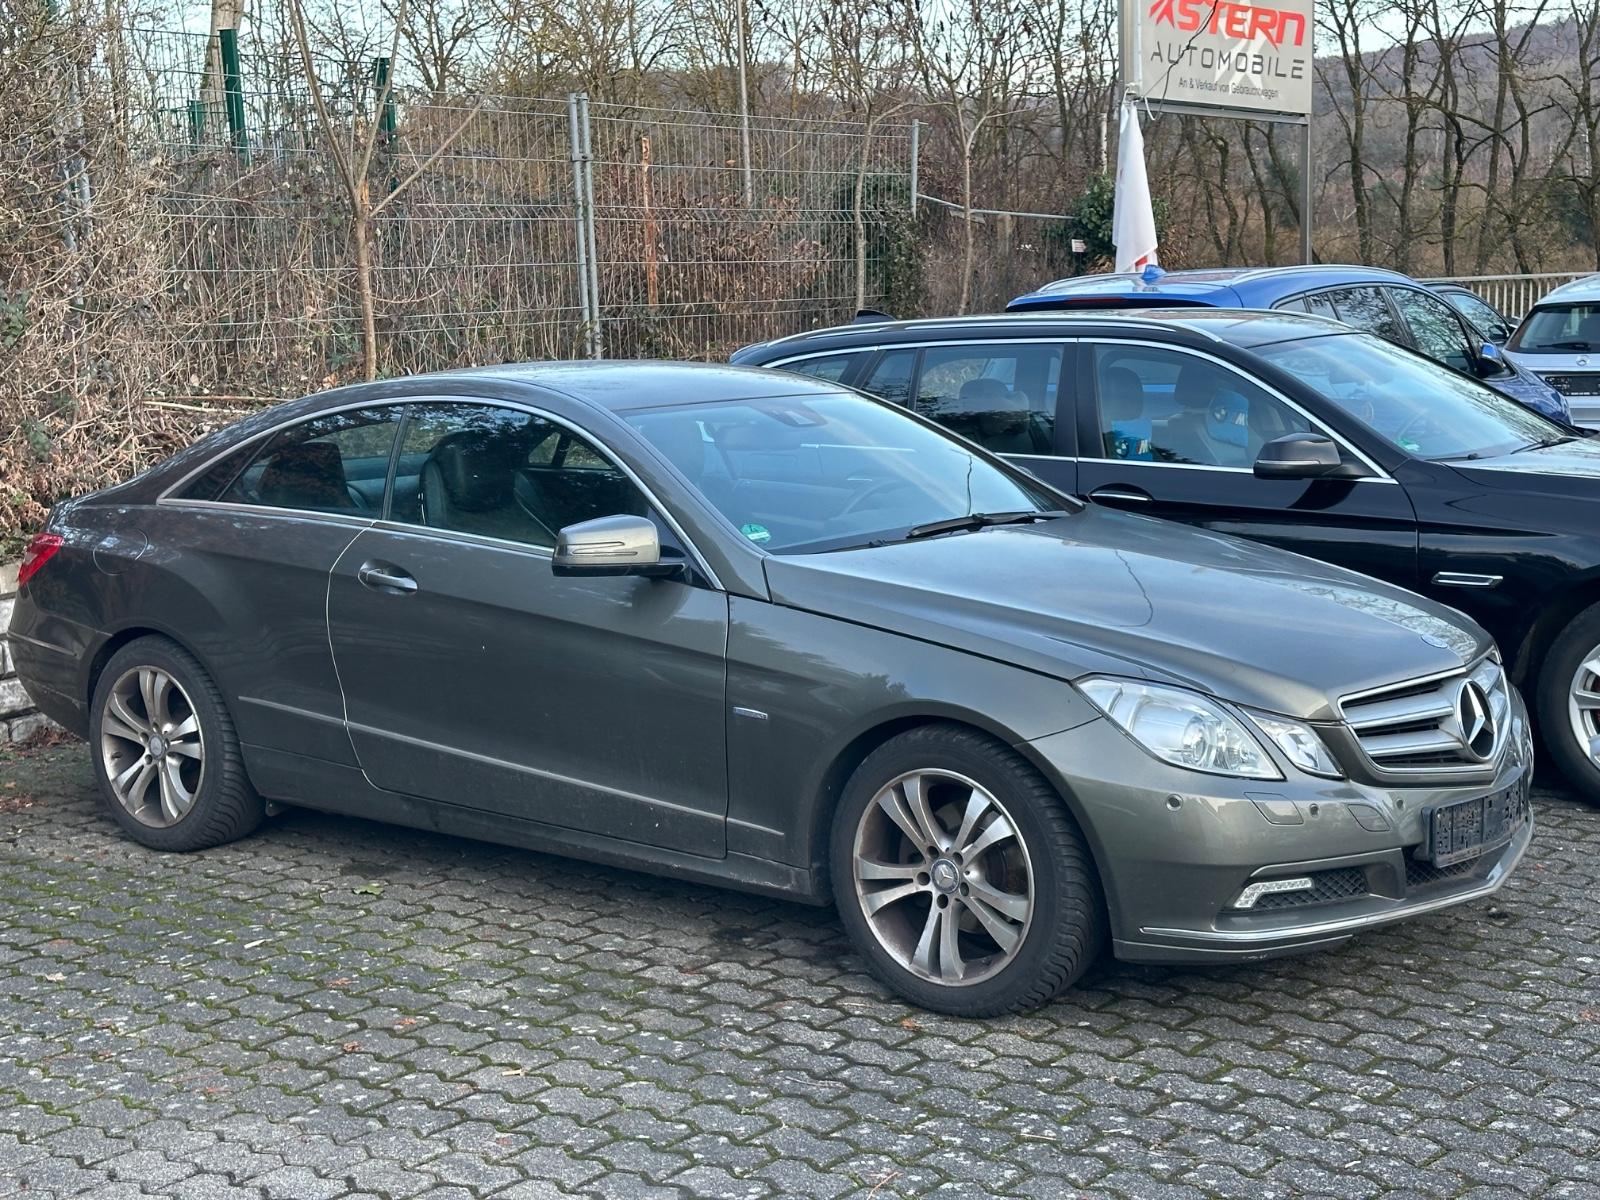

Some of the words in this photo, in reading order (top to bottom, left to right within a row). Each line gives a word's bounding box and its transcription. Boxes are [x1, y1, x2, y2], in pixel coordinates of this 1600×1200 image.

[1151, 41, 1304, 79] AUTOMOBILE
[1179, 77, 1187, 88] An
[1196, 79, 1218, 91] Verkauf
[1220, 83, 1229, 92] von
